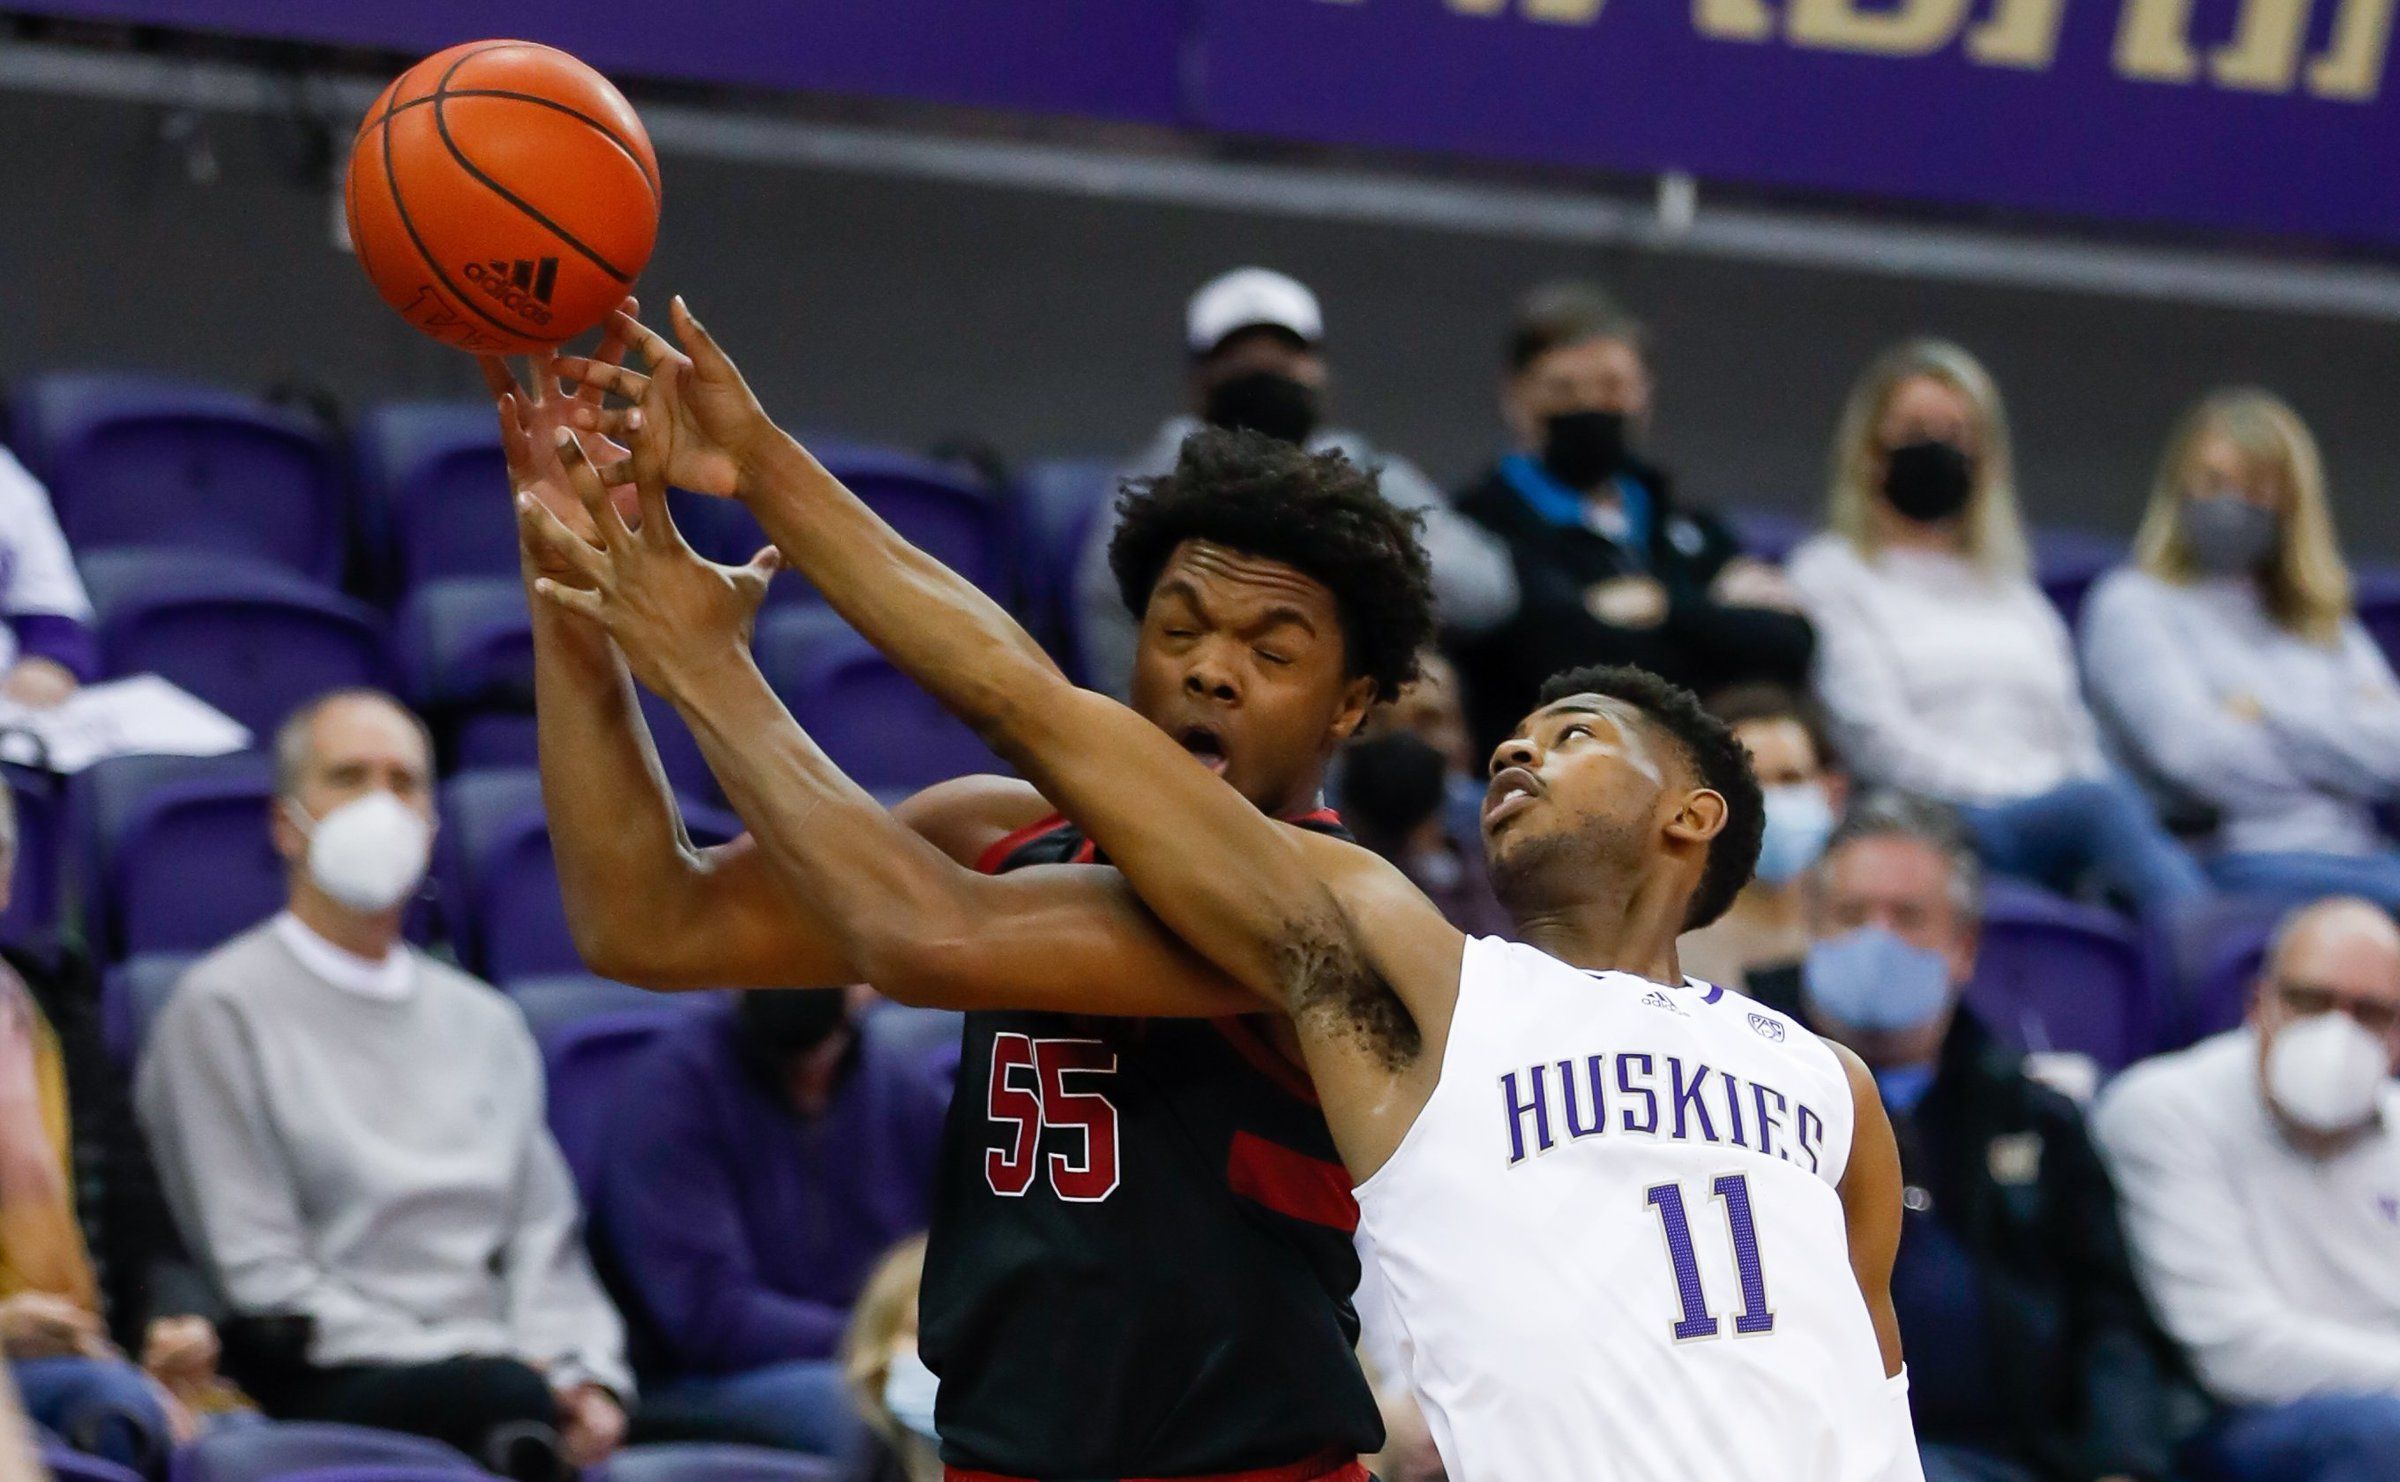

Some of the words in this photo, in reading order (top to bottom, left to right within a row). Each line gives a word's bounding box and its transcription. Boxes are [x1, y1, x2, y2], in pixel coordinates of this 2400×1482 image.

[464, 262, 552, 326] adidas
[985, 1032, 1120, 1203] 55
[1497, 1052, 1825, 1176] HUSKIES
[1643, 1170, 1776, 1345] 11
